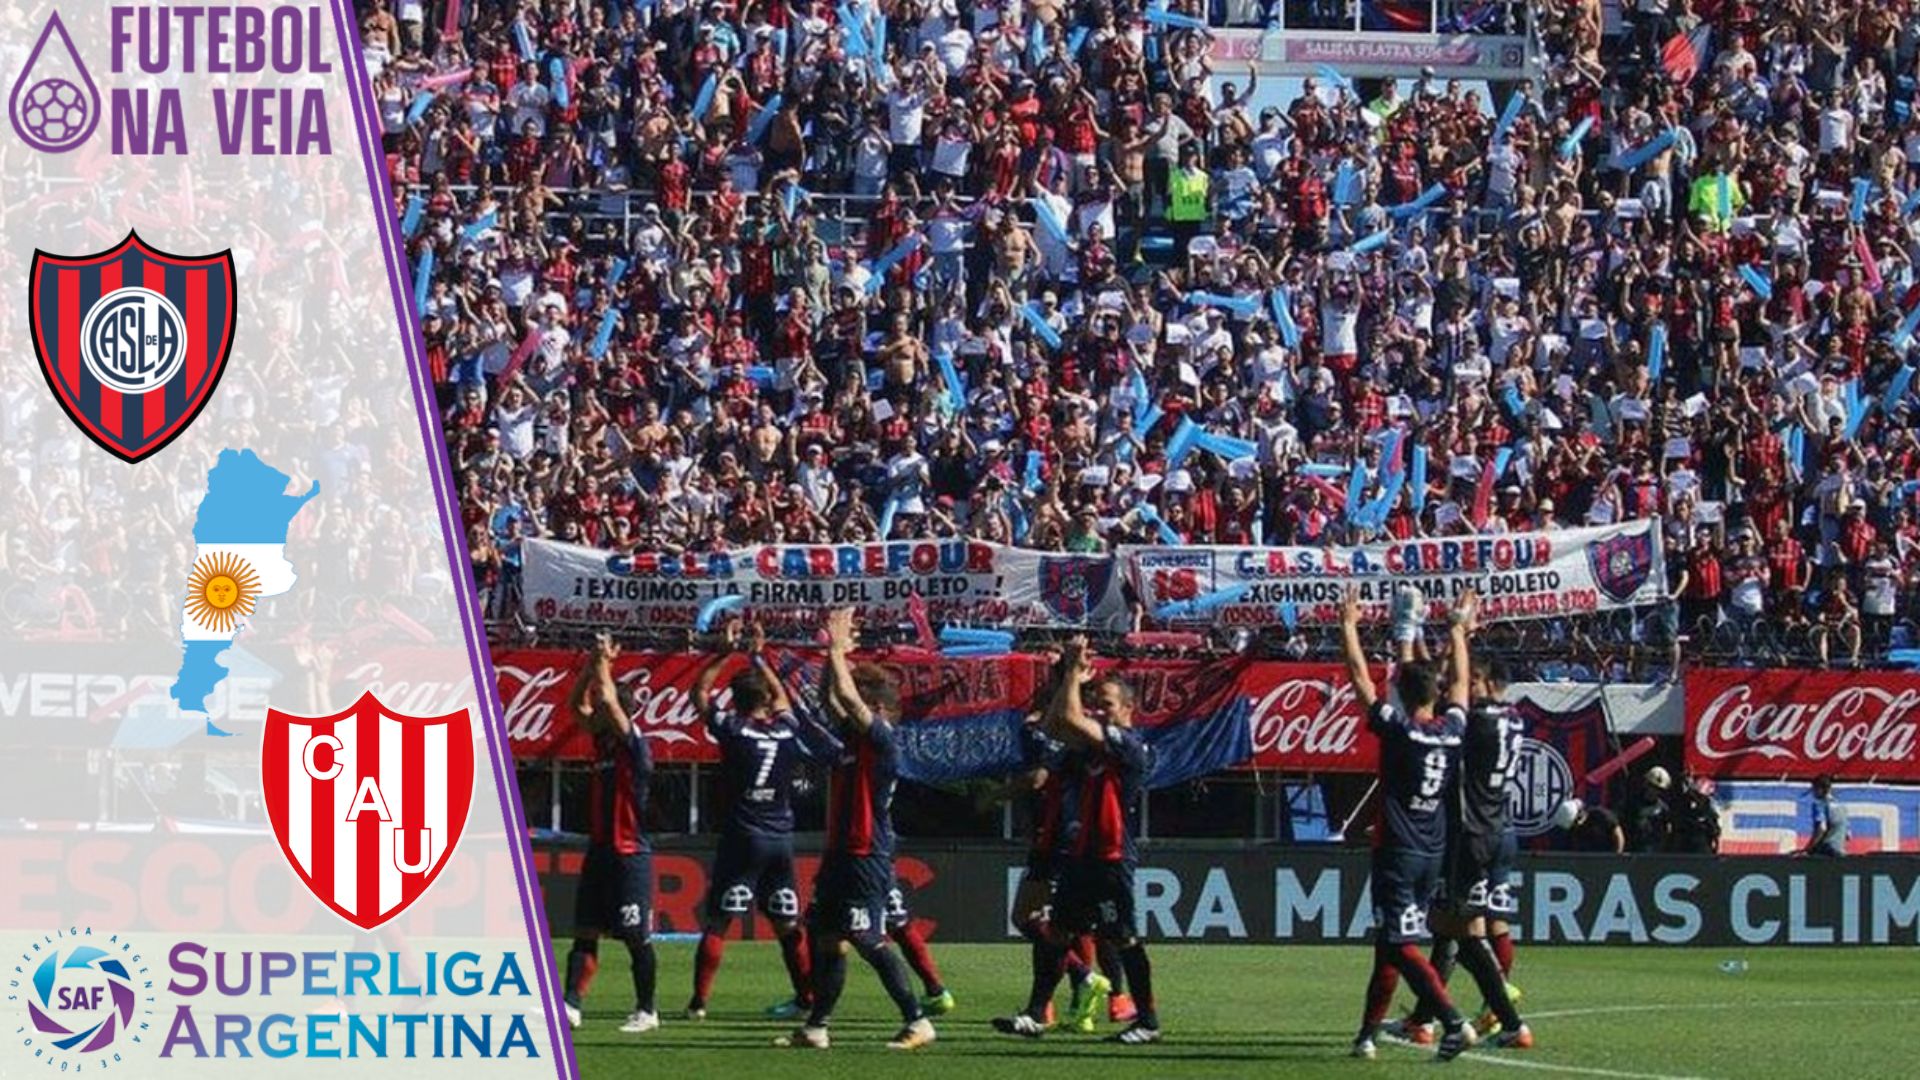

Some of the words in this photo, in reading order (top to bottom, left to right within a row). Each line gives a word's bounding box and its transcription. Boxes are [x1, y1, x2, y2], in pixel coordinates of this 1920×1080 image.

[757, 543, 993, 579] CARREFOUR
[1385, 535, 1551, 574] CARREFOUR
[750, 582, 822, 603] FIRMA
[833, 580, 871, 602] DEL
[883, 576, 968, 598] BOLETO
[1490, 570, 1560, 595] BOLETO
[1695, 684, 1920, 762] Coca-Cola
[756, 740, 778, 786] 7
[1277, 866, 1701, 944] MRAS
